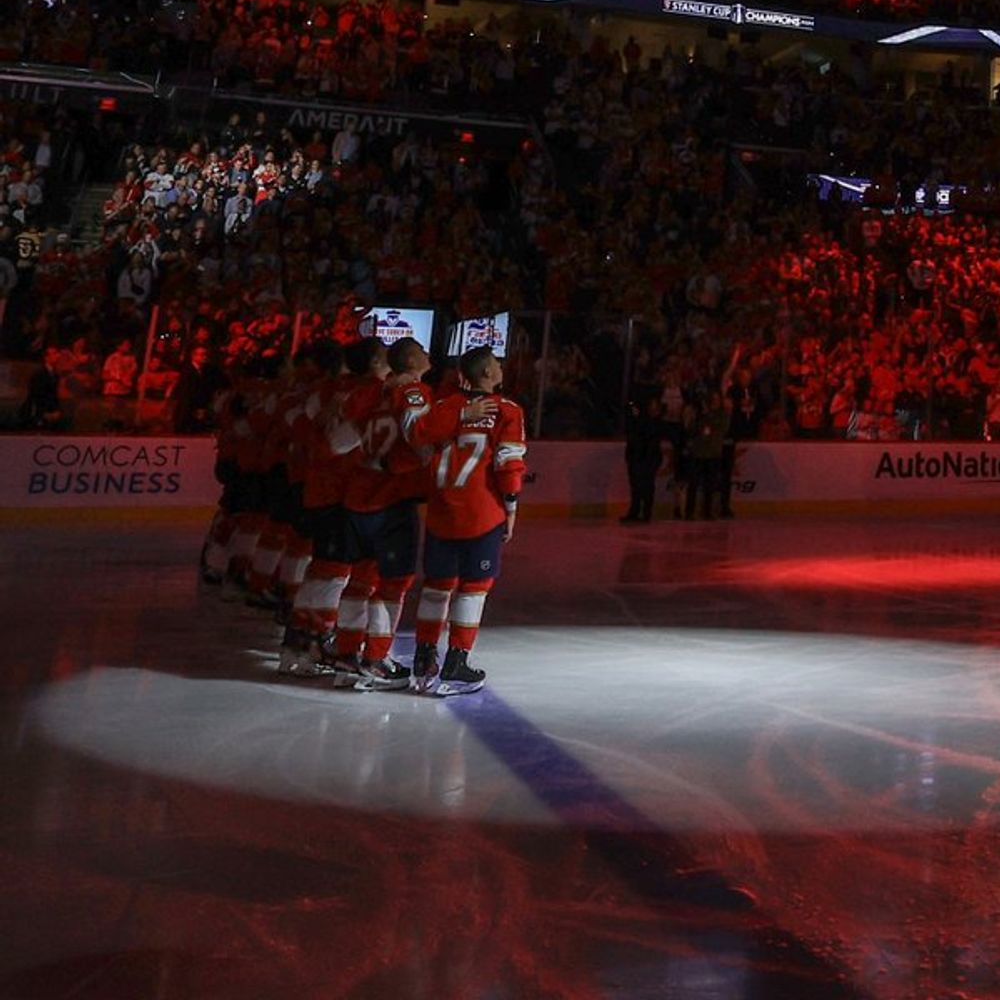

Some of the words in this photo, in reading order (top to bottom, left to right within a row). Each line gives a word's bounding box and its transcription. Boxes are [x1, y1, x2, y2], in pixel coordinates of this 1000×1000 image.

[671, 1, 711, 15] STANLEY
[713, 5, 731, 17] CUP
[745, 9, 801, 26] CHAMPIONS
[33, 445, 187, 467] COMCAST
[436, 432, 489, 489] 17
[28, 472, 182, 495] BUSINESS
